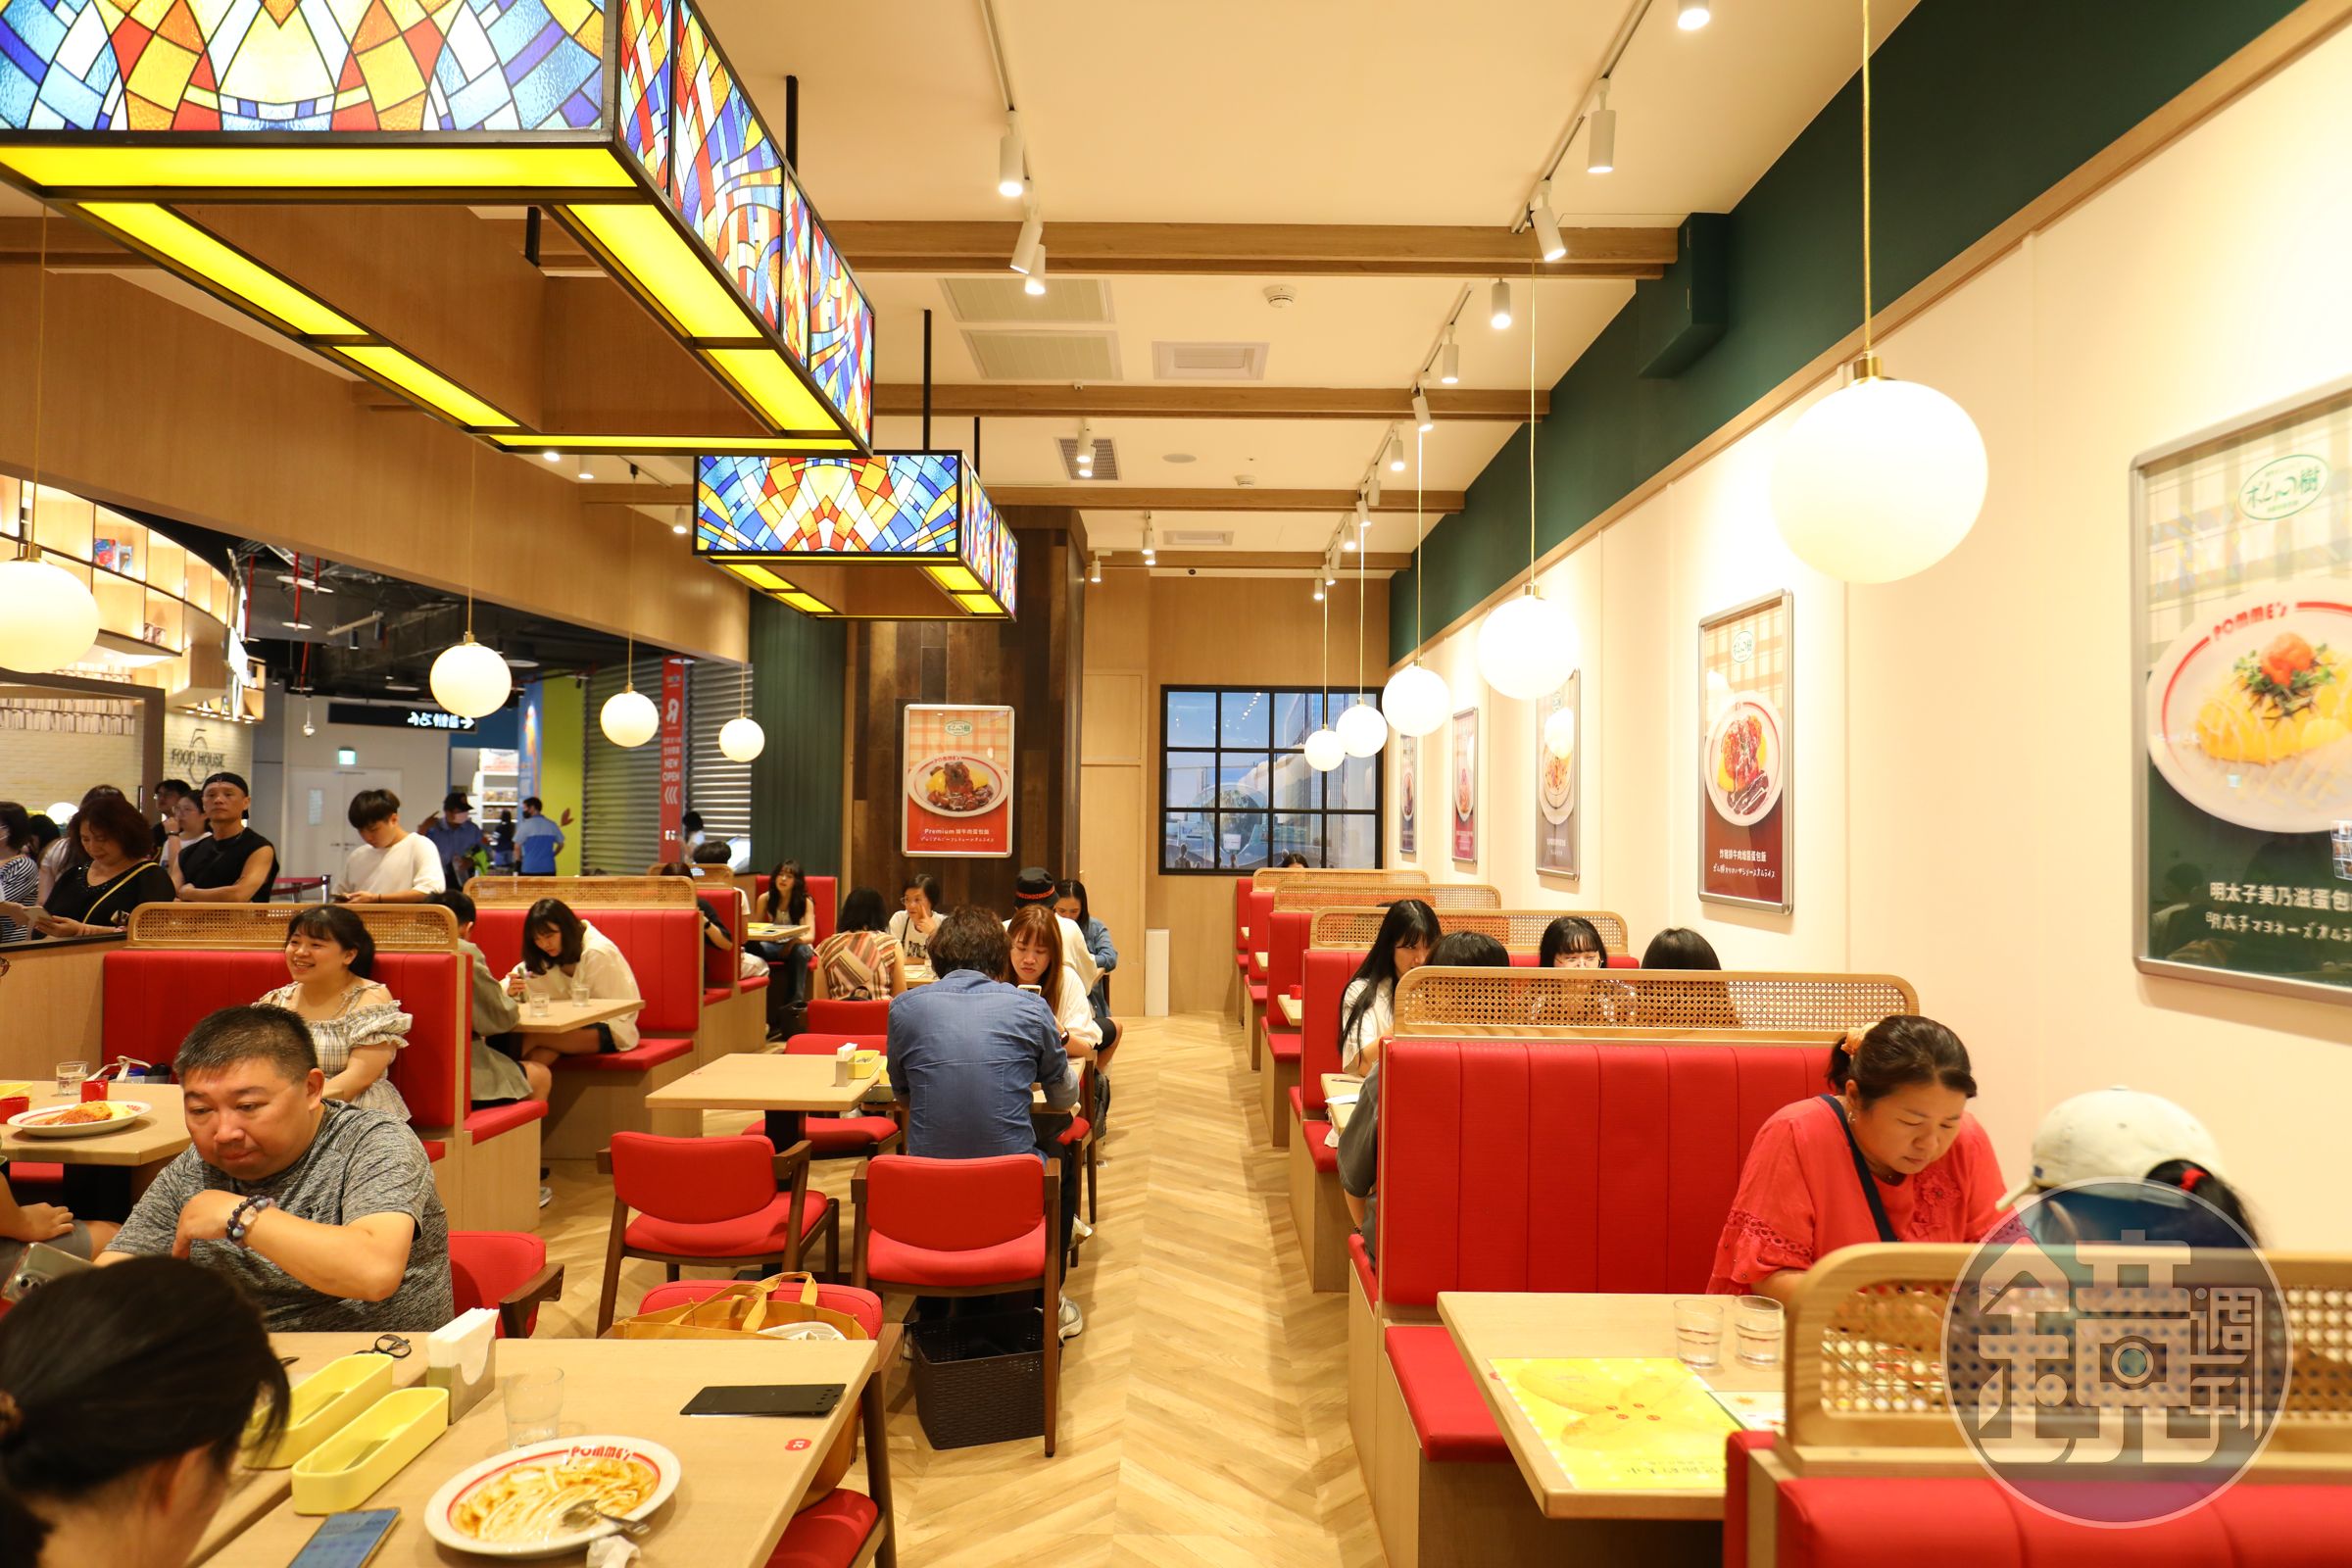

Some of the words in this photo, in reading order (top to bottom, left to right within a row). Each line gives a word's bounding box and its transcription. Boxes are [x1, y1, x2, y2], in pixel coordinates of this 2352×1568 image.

[172, 749, 195, 766] FOOD
[198, 752, 226, 767] HOUSE
[2210, 882, 2352, 912] 明太子美乃滋蛋包
